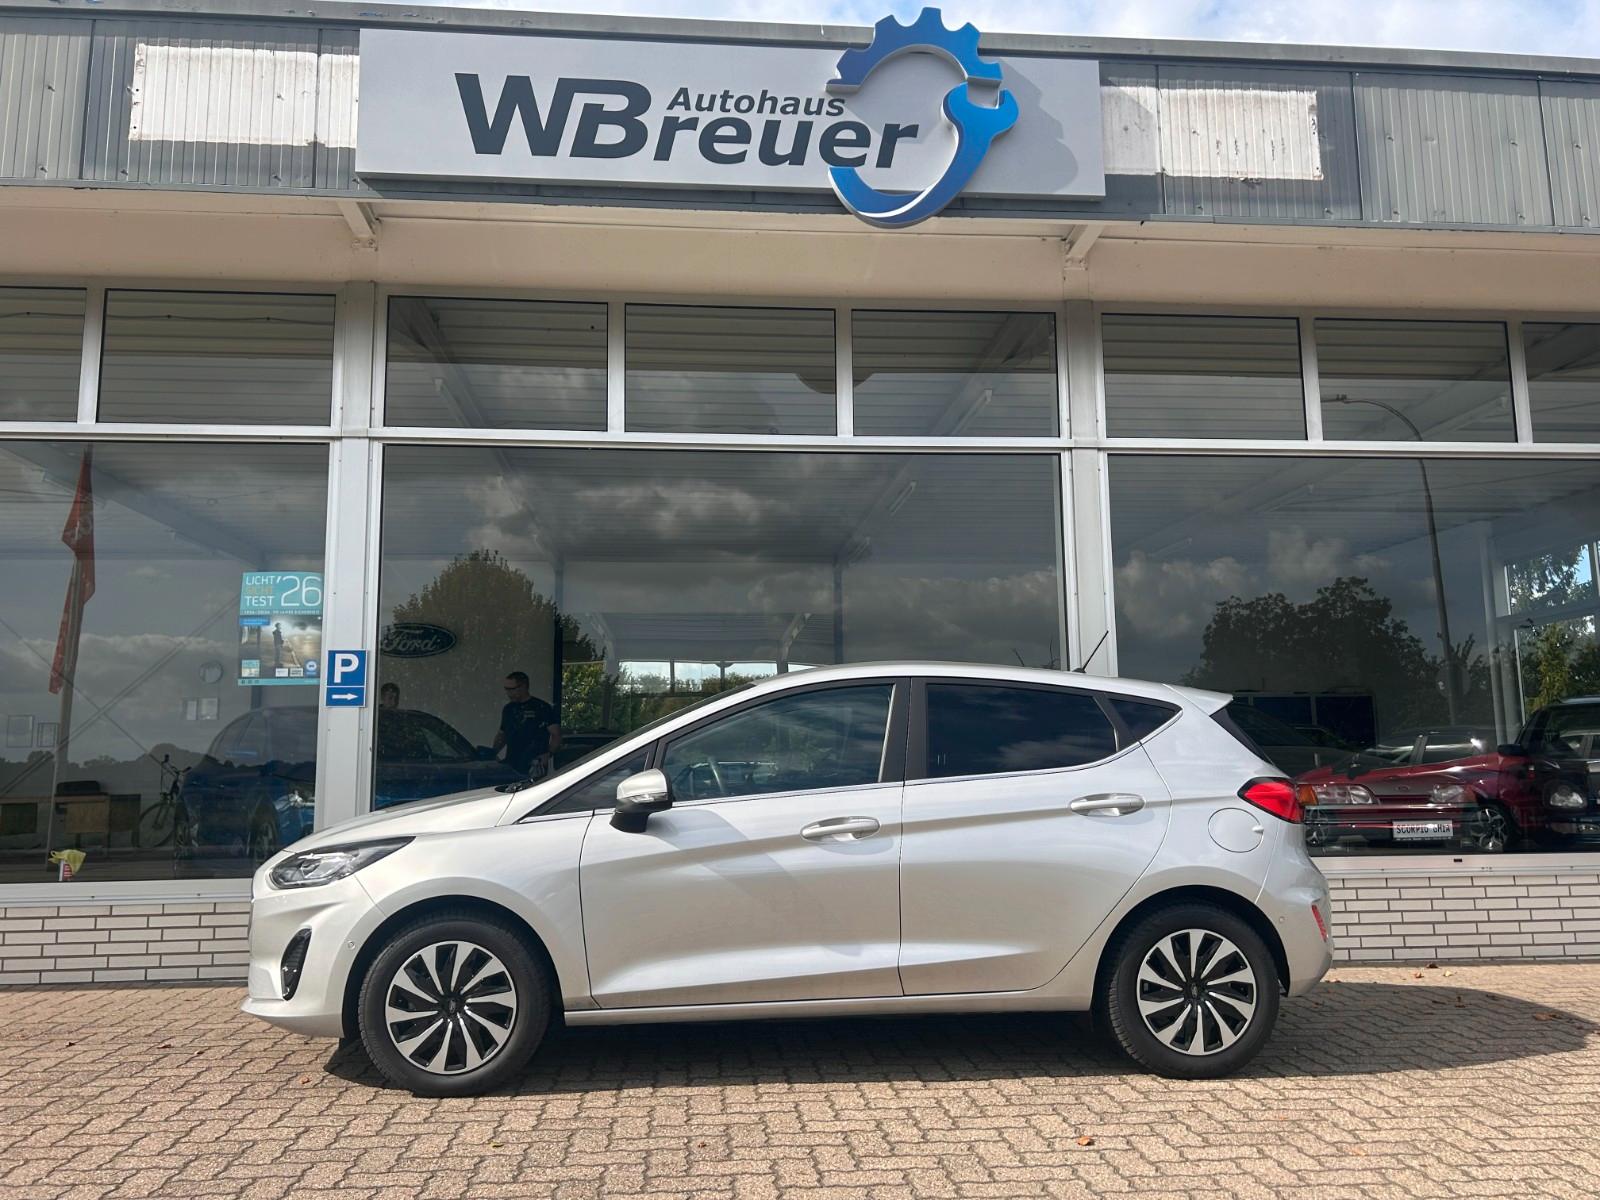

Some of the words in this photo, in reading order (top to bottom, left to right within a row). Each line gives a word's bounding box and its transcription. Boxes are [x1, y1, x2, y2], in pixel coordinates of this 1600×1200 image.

[667, 86, 846, 116] Autohaus
[245, 575, 275, 585] LICHT
[244, 595, 275, 607] TEST
[383, 628, 438, 652] Ford
[333, 653, 359, 684] P
